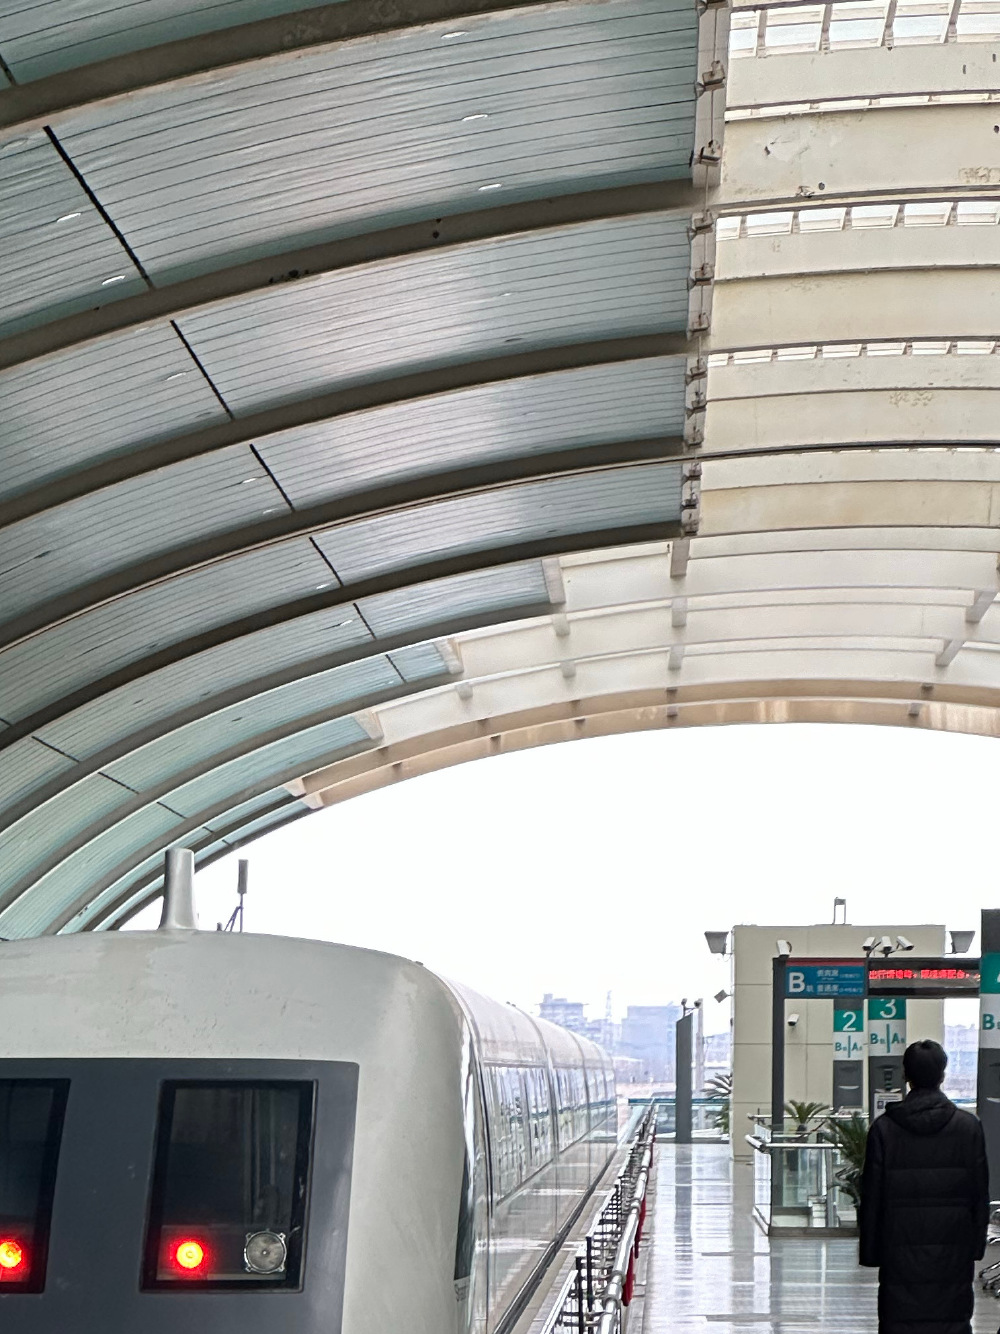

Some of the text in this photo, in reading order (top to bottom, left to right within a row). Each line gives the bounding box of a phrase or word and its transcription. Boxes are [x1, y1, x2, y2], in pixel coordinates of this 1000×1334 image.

[789, 972, 806, 993] B
[880, 999, 897, 1018] 3
[843, 1011, 856, 1031] 2
[982, 1013, 994, 1030] B
